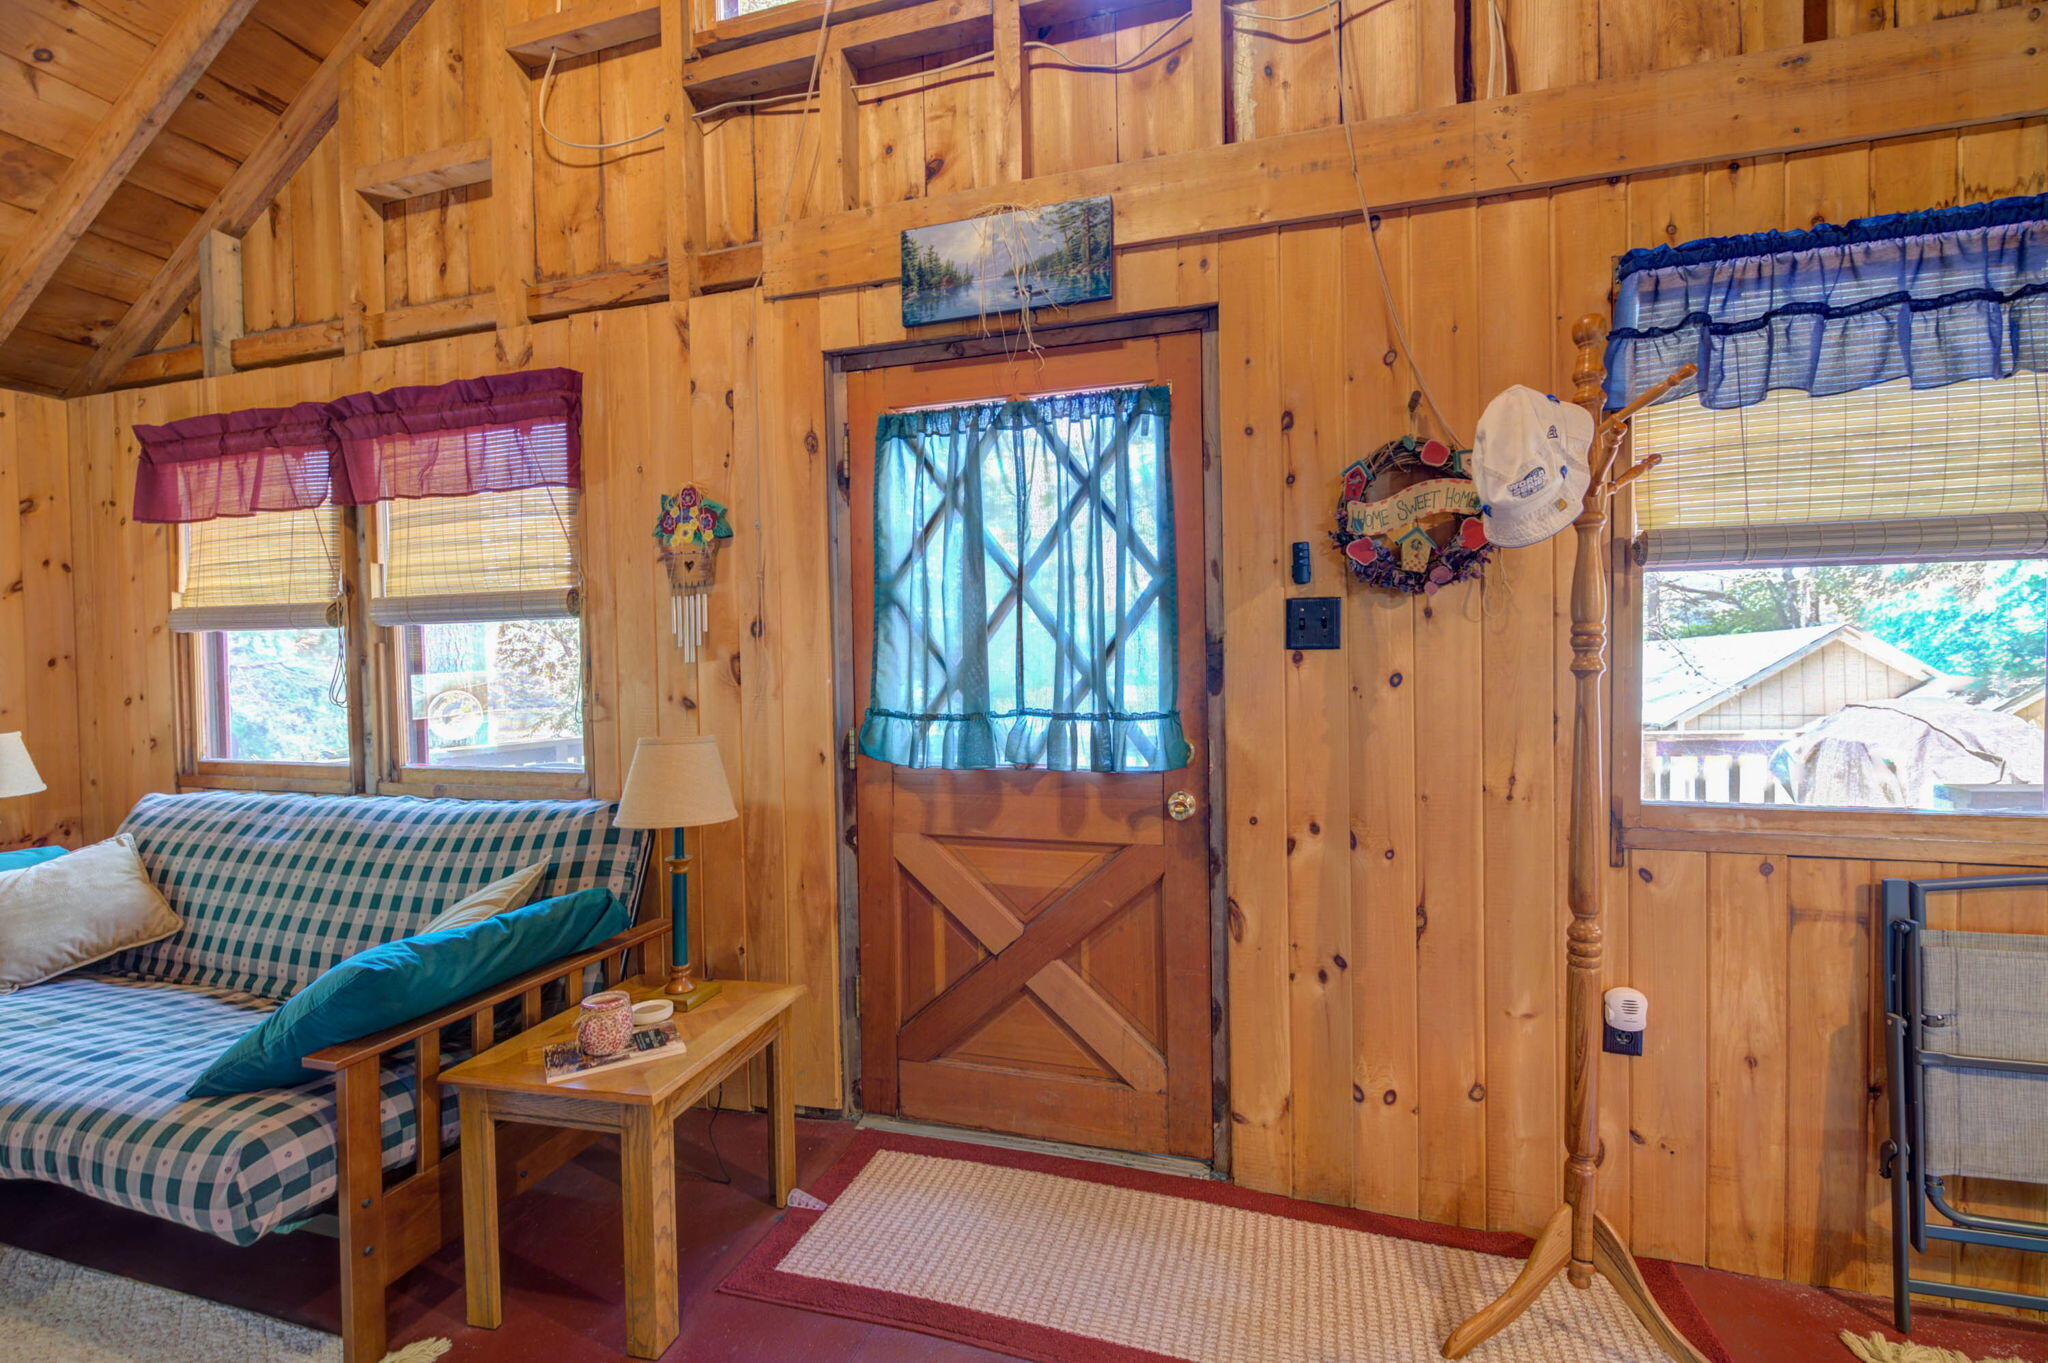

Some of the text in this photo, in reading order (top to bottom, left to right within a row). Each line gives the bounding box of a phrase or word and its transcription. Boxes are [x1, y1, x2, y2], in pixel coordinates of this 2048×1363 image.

[1508, 469, 1545, 491] WORLD
[1351, 508, 1389, 530] HOME
[1396, 490, 1441, 520] SWEET
